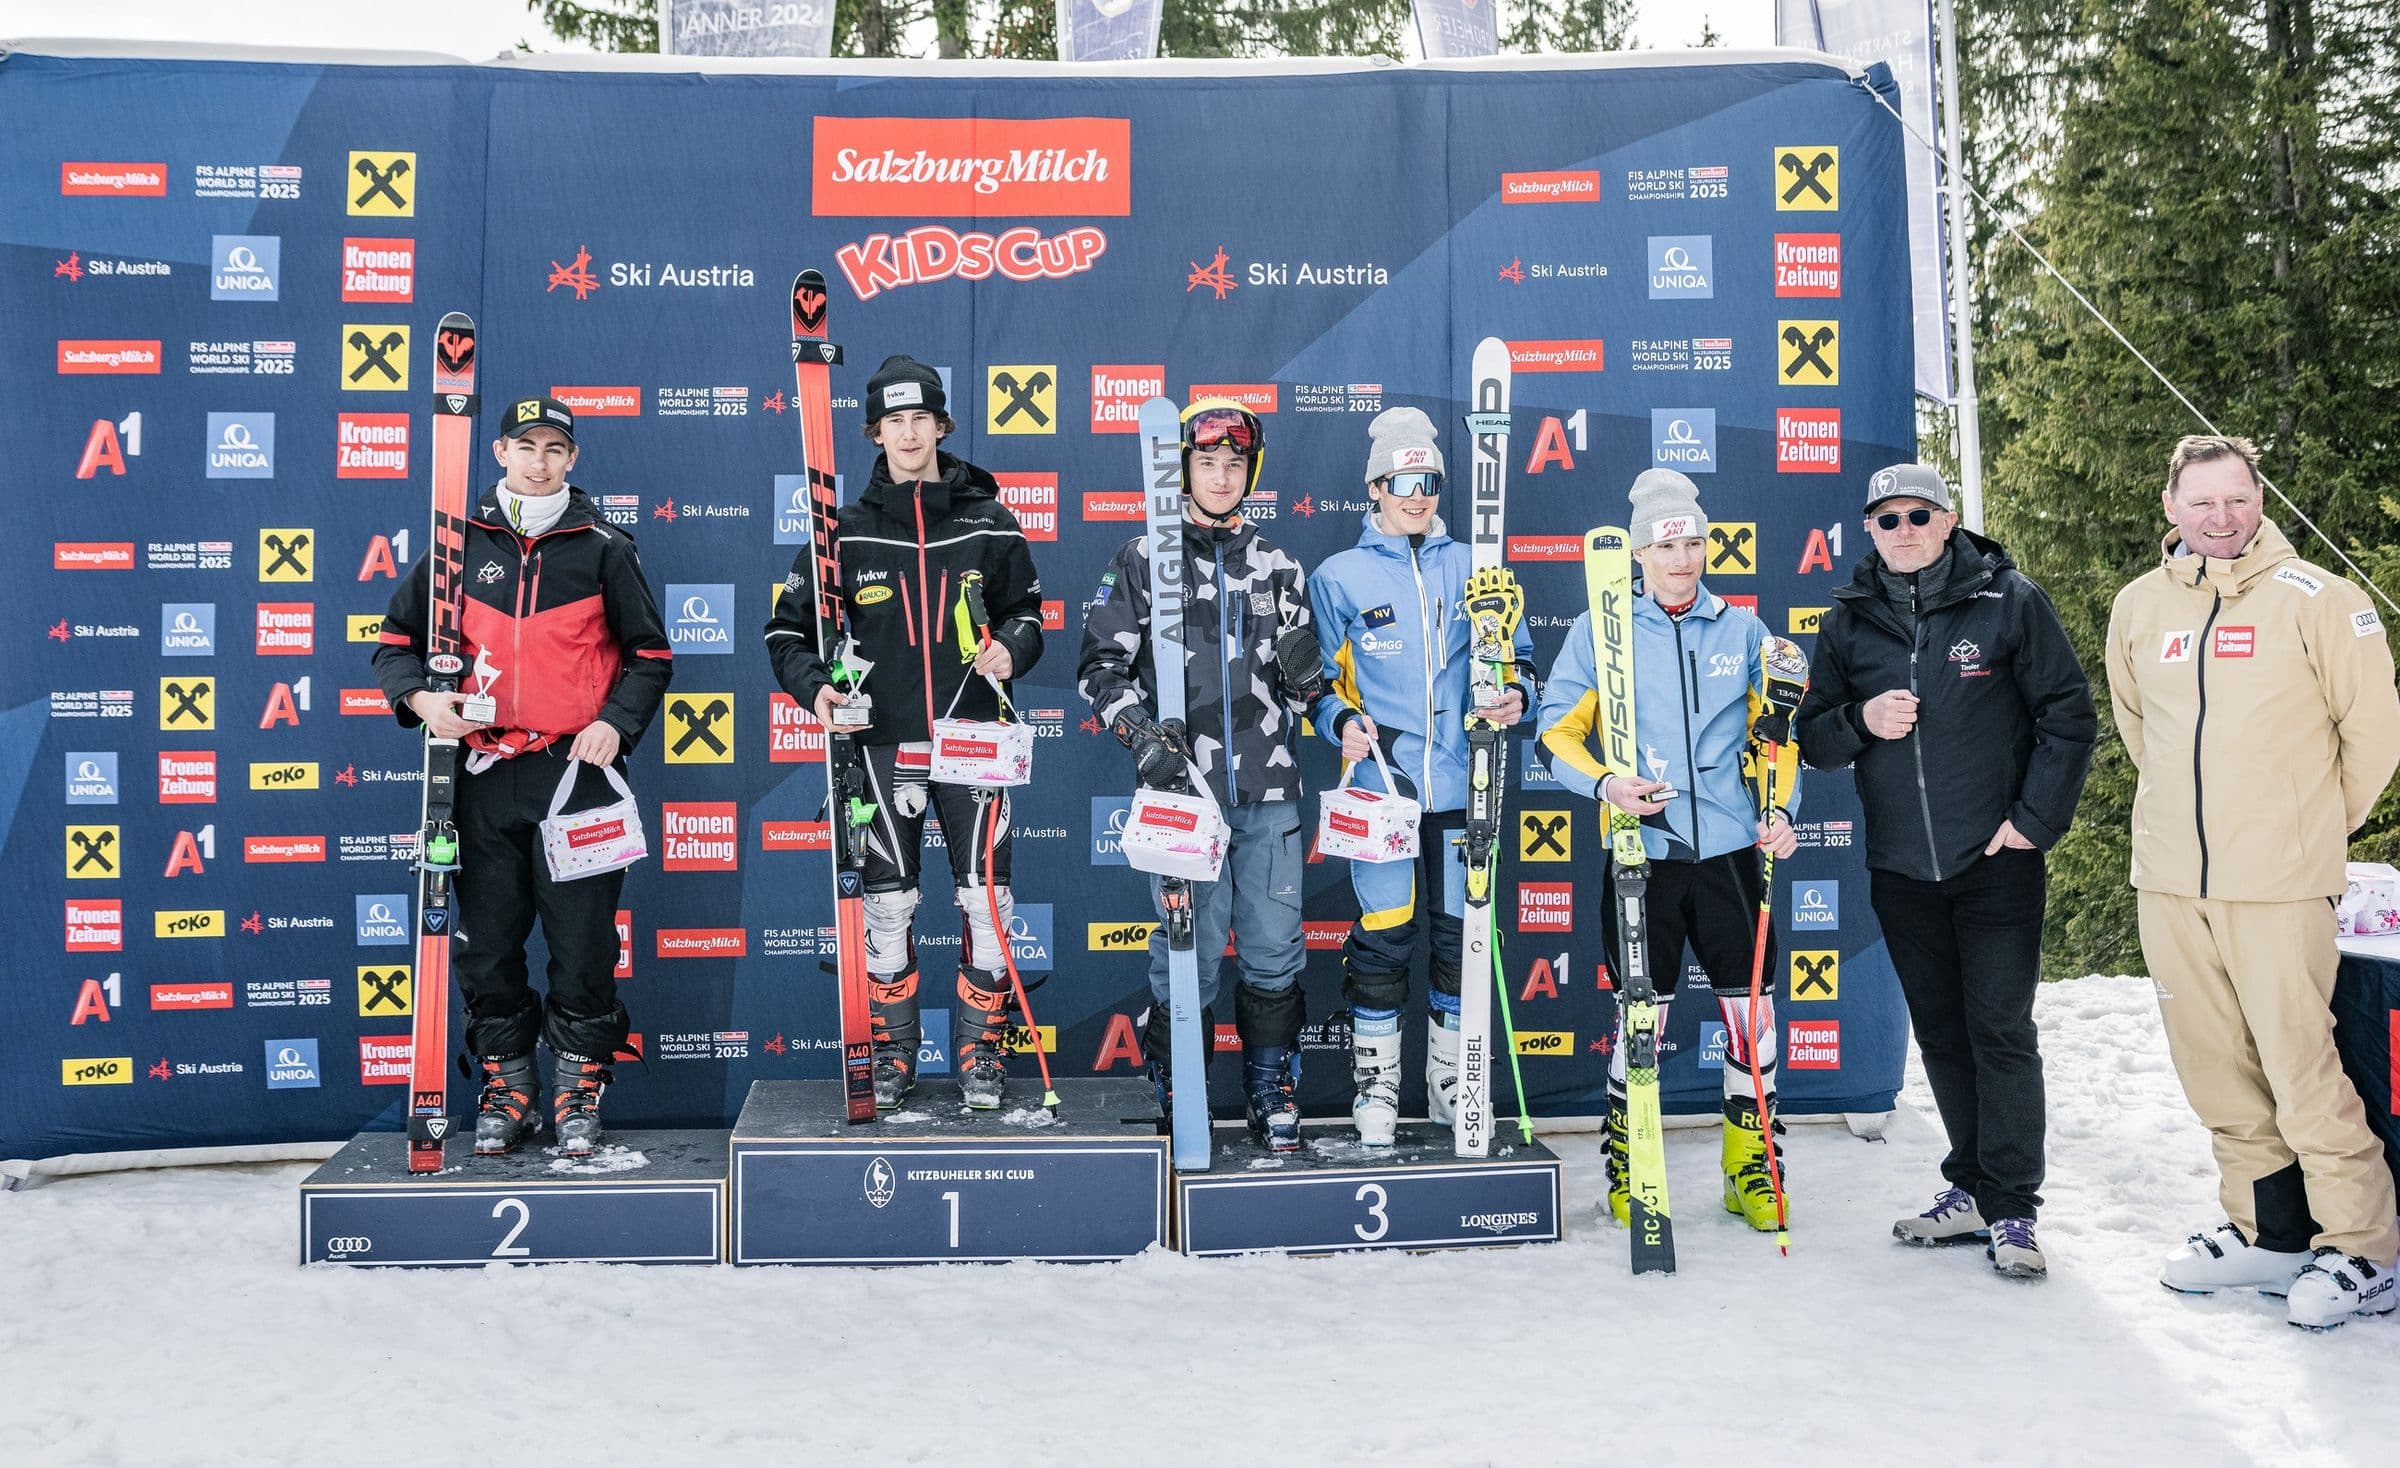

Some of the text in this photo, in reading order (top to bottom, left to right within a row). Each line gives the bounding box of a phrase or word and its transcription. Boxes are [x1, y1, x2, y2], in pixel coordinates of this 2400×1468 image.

[832, 148, 1109, 194] SalzburgMilch
[1628, 170, 1684, 180] FIS ALPINE
[260, 184, 300, 199] 2025
[1508, 180, 1592, 195] SalzburgMilch
[1628, 182, 1684, 191] WORLD SKI
[1690, 184, 1728, 198] 2025
[345, 246, 411, 268] Kronen
[1777, 242, 1837, 264] Kronen
[88, 261, 170, 276] Ski Austria
[610, 263, 754, 287] Ski Austria
[1248, 263, 1388, 284] Ski Austria
[1531, 264, 1608, 277] Ski Austria
[216, 276, 273, 291] UNIQA
[345, 271, 410, 294] Zeitung
[1653, 276, 1706, 289] UNIQA
[1778, 266, 1837, 289] Zeitung
[1632, 340, 1688, 350] FIS ALPINE
[1510, 349, 1596, 363] SalzburgMilch
[1632, 352, 1688, 360] WORLD SKI
[1694, 355, 1731, 370] 2025
[254, 359, 294, 374] 2025
[659, 388, 709, 397] FIS ALPINE
[1095, 375, 1162, 396] Kronen
[1296, 386, 1344, 394] FIS ALPINE
[659, 399, 709, 407] WORLD SKI
[1296, 396, 1344, 404] WORLD SKI
[1348, 399, 1382, 412] 2025
[714, 402, 747, 415] 2025
[340, 422, 407, 444] Kronen
[1779, 417, 1837, 439] Kronen
[340, 446, 406, 469] Zeitung
[1657, 449, 1710, 462] UNIQA
[1780, 441, 1837, 463] Zeitung
[212, 453, 268, 468] UNIQA
[1475, 377, 1501, 544] HEAD
[605, 510, 637, 524] 2025
[682, 506, 749, 517] Ski Austria
[1244, 506, 1276, 519] 2025
[1152, 436, 1185, 645] AUGMENT
[1512, 542, 1579, 554] SalzburgMilch
[199, 556, 231, 568] 2025
[259, 610, 311, 627] Kronen
[1374, 607, 1391, 619] NV
[74, 626, 139, 637] Ski Austria
[671, 628, 728, 642] UNIQA
[2217, 631, 2253, 641] Kronen
[166, 636, 210, 647] UNIQA
[258, 630, 311, 648] Zeitung
[2217, 642, 2252, 652] Zeitung
[1601, 590, 1632, 768] FISCHER
[100, 705, 133, 717] 2025
[162, 758, 214, 776] Kronen
[262, 766, 304, 785] TOKO
[362, 770, 426, 782] Ski Austria
[70, 785, 113, 796] UNIQA
[161, 778, 214, 796] Zeitung
[666, 812, 734, 834] Kronen
[340, 836, 352, 844] FIS
[1824, 835, 1851, 846] 2025
[340, 845, 386, 853] WORLD SKI
[666, 837, 734, 861] Zeitung
[1521, 889, 1569, 905] Kronen
[68, 907, 119, 924] Kronen
[268, 917, 333, 928] Ski Austria
[1521, 908, 1569, 924] Zeitung
[1795, 911, 1834, 922] UNIQA
[167, 914, 210, 933] TOKO
[68, 927, 120, 945] Zeitung
[360, 926, 404, 937] UNIQA
[764, 929, 814, 937] FIS ALPINE
[1100, 925, 1147, 947] TOKO
[764, 939, 814, 947] WORLD SKI
[919, 934, 961, 945] Austria
[248, 982, 294, 990] FIS ALPINE
[248, 992, 279, 1000] WORLD
[299, 994, 331, 1006] 2025
[1358, 1023, 1393, 1032] HEAD
[660, 1034, 710, 1042] FIS ALPINE
[1790, 1029, 1837, 1044] Kronen
[362, 1043, 412, 1060] Kronen
[1520, 1035, 1562, 1054] TOKO
[715, 1046, 748, 1058] 2025
[848, 1045, 869, 1059] A40
[1790, 1046, 1837, 1062] Zeitung
[75, 1063, 118, 1081] TOKO
[177, 1062, 243, 1074] Ski Austria
[271, 1069, 315, 1081] UNIQA
[363, 1061, 412, 1078] Zeitung
[416, 1095, 440, 1108] A40
[907, 1170, 1034, 1181] KITZBUHELER SKI CLUB
[1354, 1184, 1388, 1240] 3
[942, 1191, 960, 1248] 1
[1461, 1212, 1537, 1228] LONGINES
[491, 1198, 530, 1256] 2
[2358, 1277, 2394, 1304] HEAD
